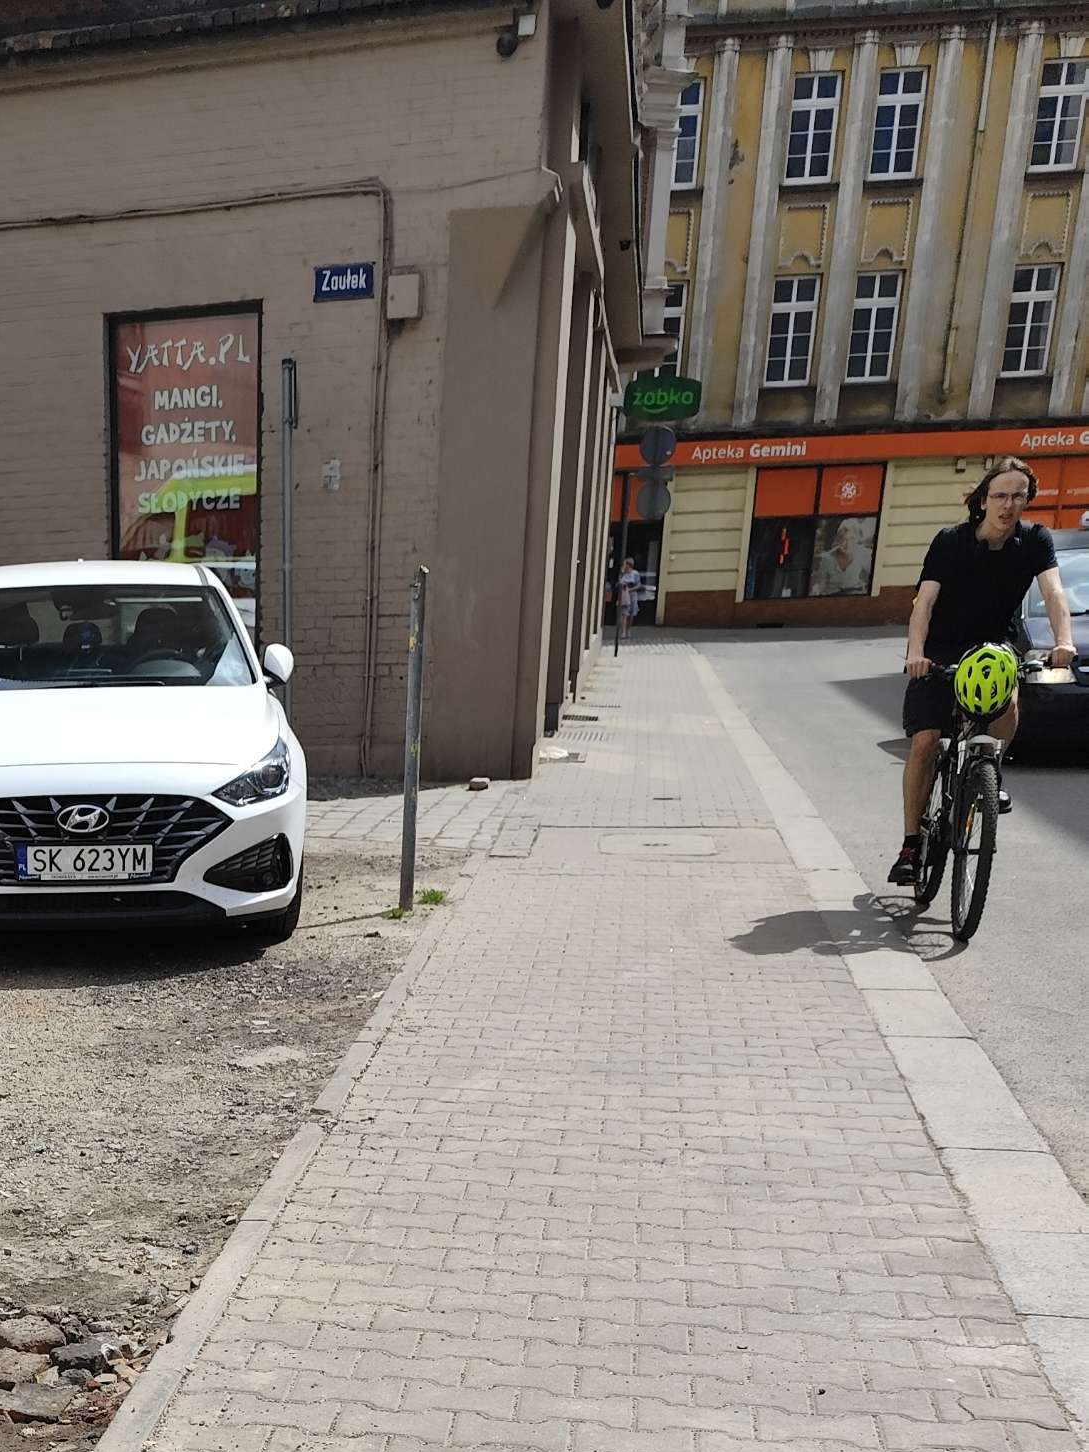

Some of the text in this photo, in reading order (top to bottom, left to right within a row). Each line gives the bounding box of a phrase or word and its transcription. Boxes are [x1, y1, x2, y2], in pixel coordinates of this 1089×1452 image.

[321, 267, 367, 291] Zaułek
[126, 333, 250, 374] YATTA.PL
[154, 384, 223, 410] MANGI,
[141, 416, 236, 446] GADŻETY,
[1020, 432, 1075, 451] Apteka
[692, 441, 807, 463] Apteka Gemini
[135, 450, 245, 482] JAPOŃSKIE
[138, 488, 241, 514] SŁODYCZE
[18, 863, 27, 871] PL
[33, 848, 147, 872] SK 623YM
